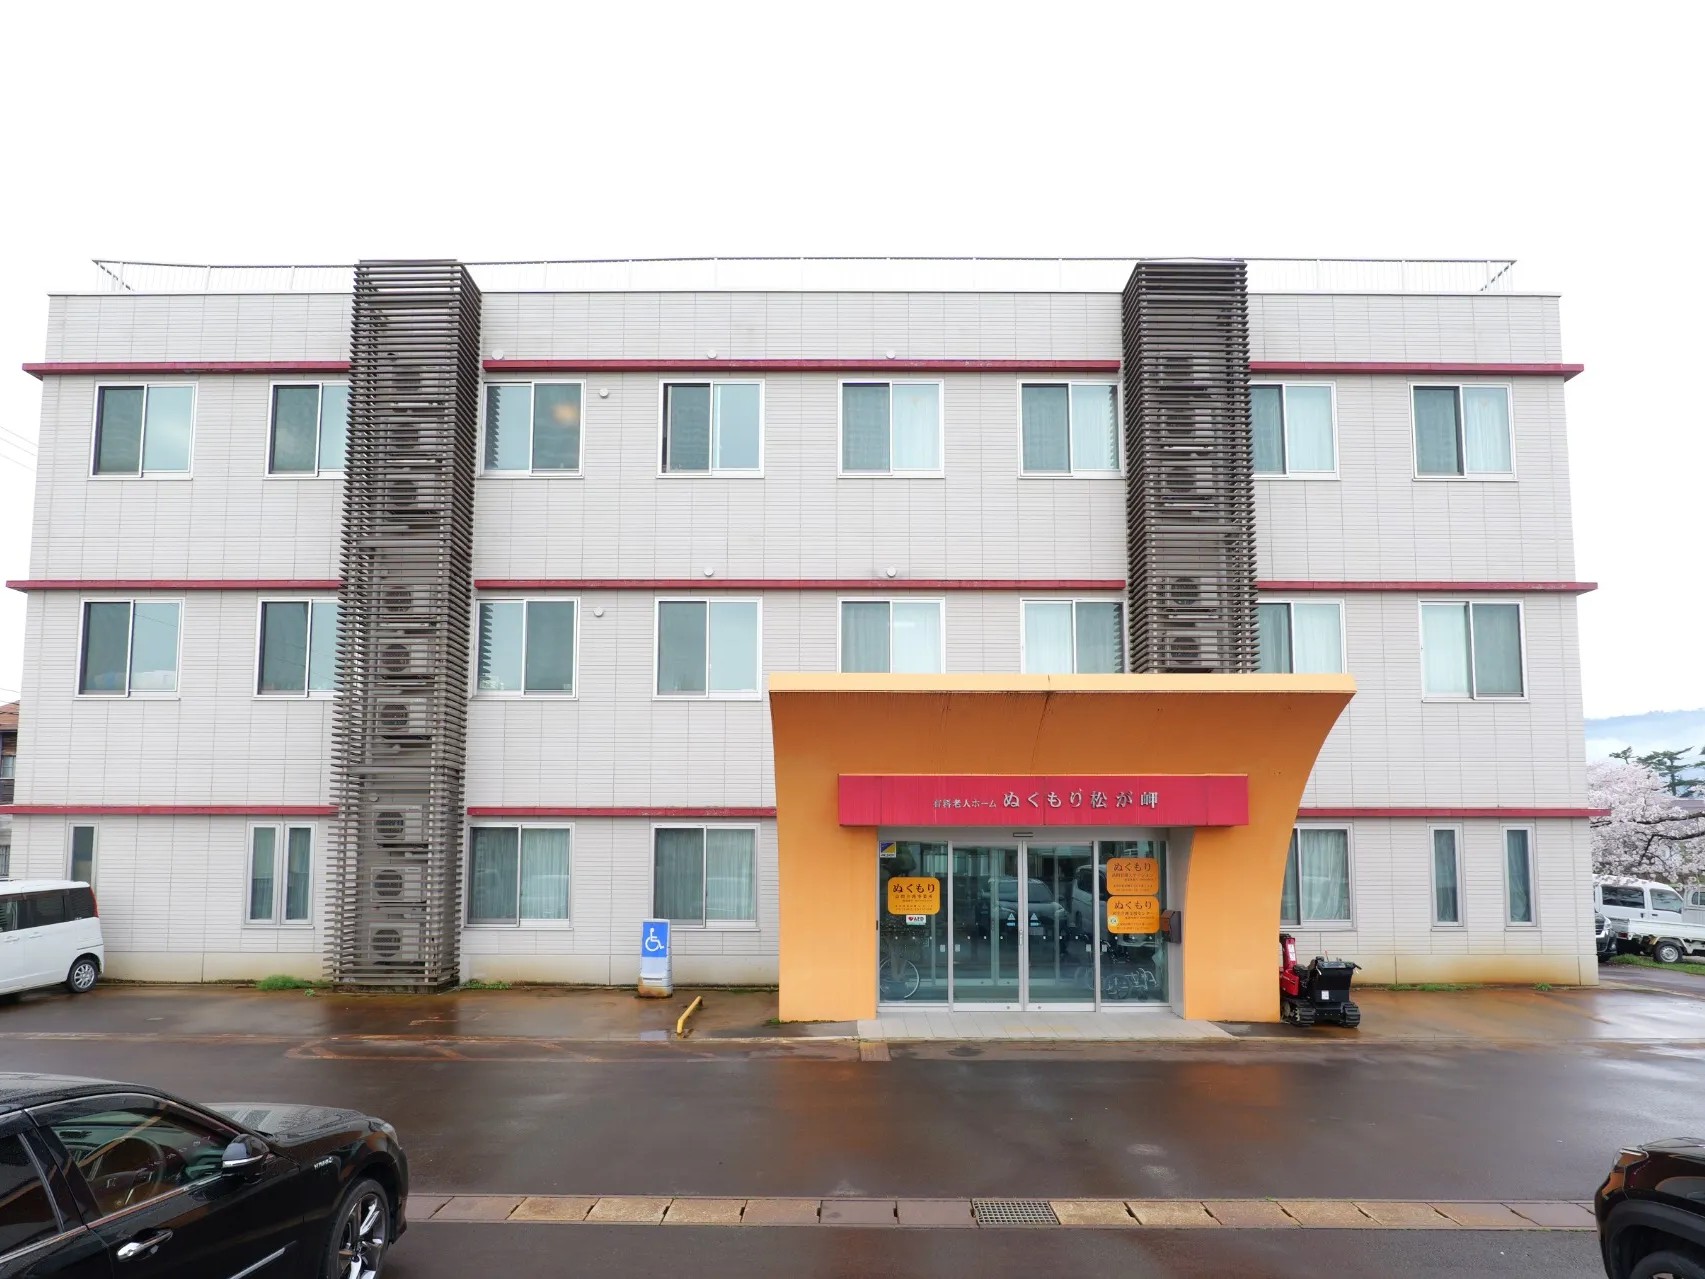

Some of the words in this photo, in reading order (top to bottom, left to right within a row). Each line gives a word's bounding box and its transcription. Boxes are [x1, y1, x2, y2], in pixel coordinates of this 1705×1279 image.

[1003, 791, 1158, 809] ぬくもり松が岬
[1113, 862, 1151, 872] ぬくもり
[892, 883, 935, 894] ぬくもり
[1114, 900, 1152, 910] ぬくもり
